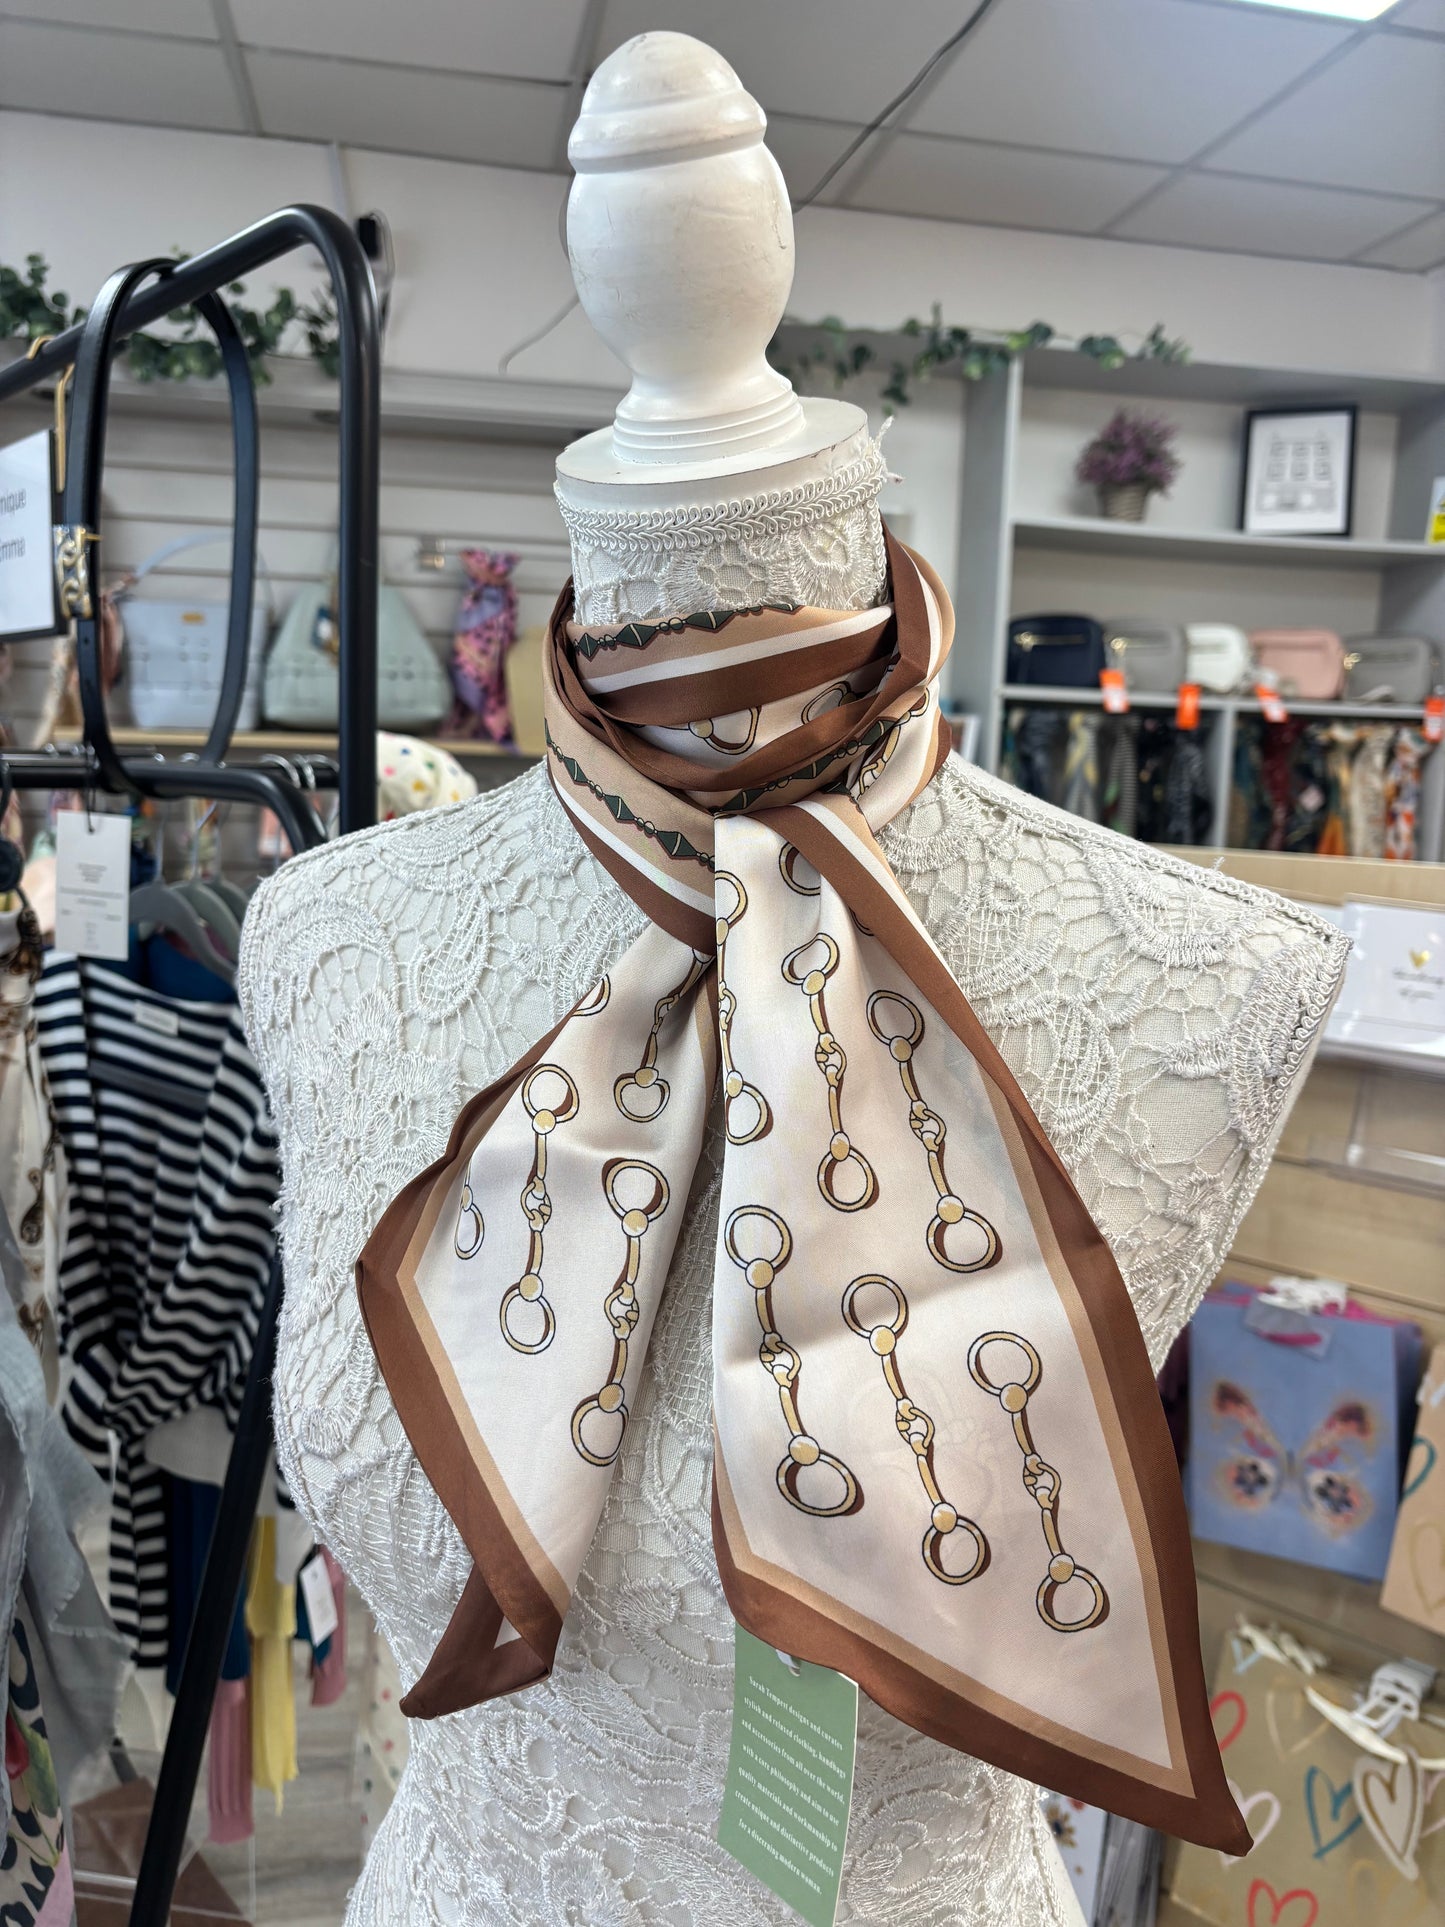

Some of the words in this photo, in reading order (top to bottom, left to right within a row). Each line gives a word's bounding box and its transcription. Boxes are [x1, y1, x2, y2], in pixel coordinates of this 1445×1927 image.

[742, 1719, 751, 1731] and
[752, 1727, 781, 1754] accessories
[781, 1748, 795, 1765] from
[795, 1760, 803, 1772] all
[803, 1767, 816, 1781] over
[816, 1776, 826, 1789] the
[744, 1696, 761, 1714] stylish
[762, 1710, 772, 1723] and
[772, 1718, 793, 1738] relaxed
[793, 1734, 818, 1758] clothing,
[818, 1751, 846, 1779] handbags
[749, 1675, 765, 1694] Sarah
[766, 1687, 788, 1710] Tempest
[788, 1705, 809, 1726] designs
[810, 1721, 820, 1735] and
[821, 1730, 843, 1751] curates
[738, 1766, 756, 1787] quality
[757, 1782, 782, 1807] materials
[782, 1803, 793, 1816] and
[793, 1811, 831, 1848] workmanship
[742, 1744, 754, 1758] with
[759, 1757, 770, 1771] core
[770, 1766, 799, 1796] philosophy
[800, 1790, 811, 1804] and
[811, 1799, 822, 1813] aim
[829, 1814, 839, 1827] use
[735, 1790, 751, 1808] create
[751, 1803, 770, 1823] unique
[770, 1819, 780, 1832] and
[780, 1826, 809, 1856] distinctive
[809, 1852, 834, 1878] products
[739, 1818, 747, 1831] for
[751, 1829, 779, 1860] discerning
[779, 1854, 801, 1876] modern
